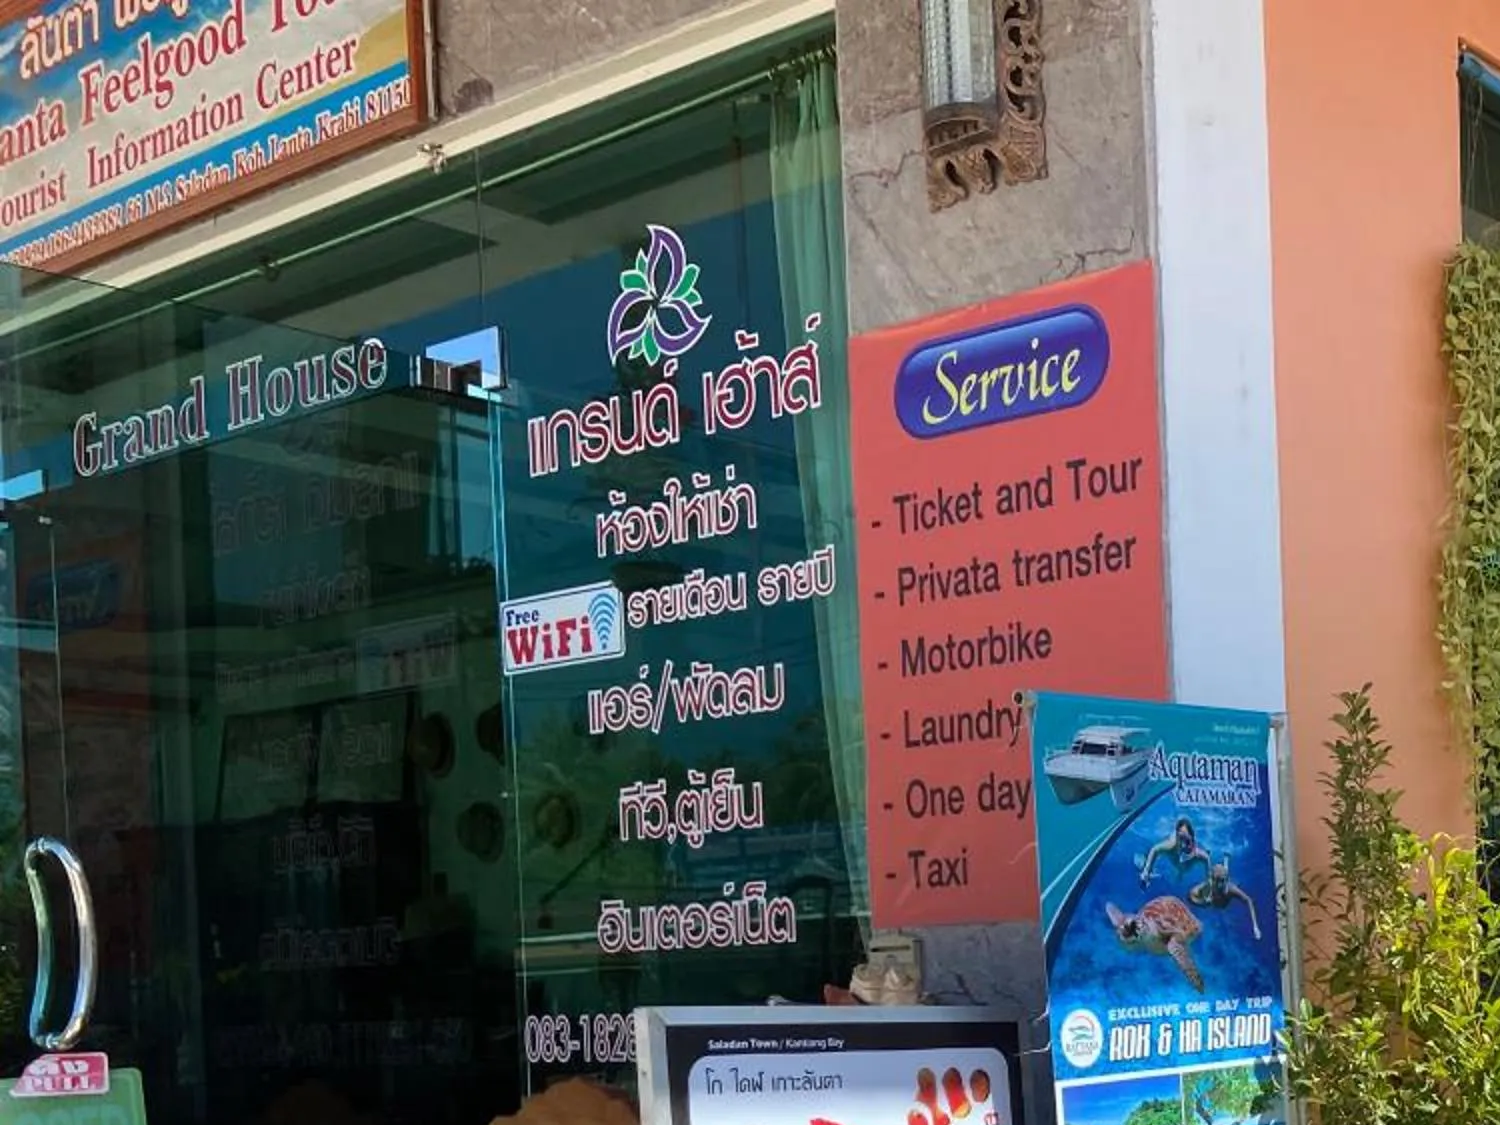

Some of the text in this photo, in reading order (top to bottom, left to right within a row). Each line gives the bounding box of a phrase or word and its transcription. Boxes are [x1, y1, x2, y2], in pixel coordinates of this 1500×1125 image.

[79, 0, 246, 127] Feelgood
[87, 99, 243, 190] Information
[256, 35, 358, 110] Center
[316, 95, 363, 143] Krabi
[73, 337, 388, 477] Grand House
[922, 338, 1081, 425] Service
[527, 359, 680, 478] แกรนด์
[596, 464, 757, 558] ห้องให้เช่า
[893, 482, 983, 534] Ticket
[996, 466, 1053, 516] and
[1066, 457, 1143, 500] Tour
[627, 544, 836, 628] รายเดือน รายปี
[897, 558, 1001, 607] Privata
[1013, 533, 1136, 586] transfer
[506, 609, 539, 627] Free
[507, 615, 592, 665] WiFi
[901, 622, 1053, 677] Motorbike
[588, 660, 785, 735] แอร์/พัดลม
[904, 699, 1022, 748] Laundry
[906, 779, 964, 819] One
[977, 772, 1032, 818] day
[1148, 739, 1262, 796] Aquaman
[619, 768, 764, 848] ทีวี,ตู้เย็น
[908, 849, 969, 889] Taxi
[599, 881, 797, 953] อินเตอร์เน็ต
[1108, 996, 1273, 1021] EXCLUSIVE ONE DAY TRIP
[1158, 1023, 1172, 1055] &
[1207, 1013, 1272, 1051] ISLAND
[750, 1039, 779, 1049] Town
[705, 1067, 722, 1095] โก
